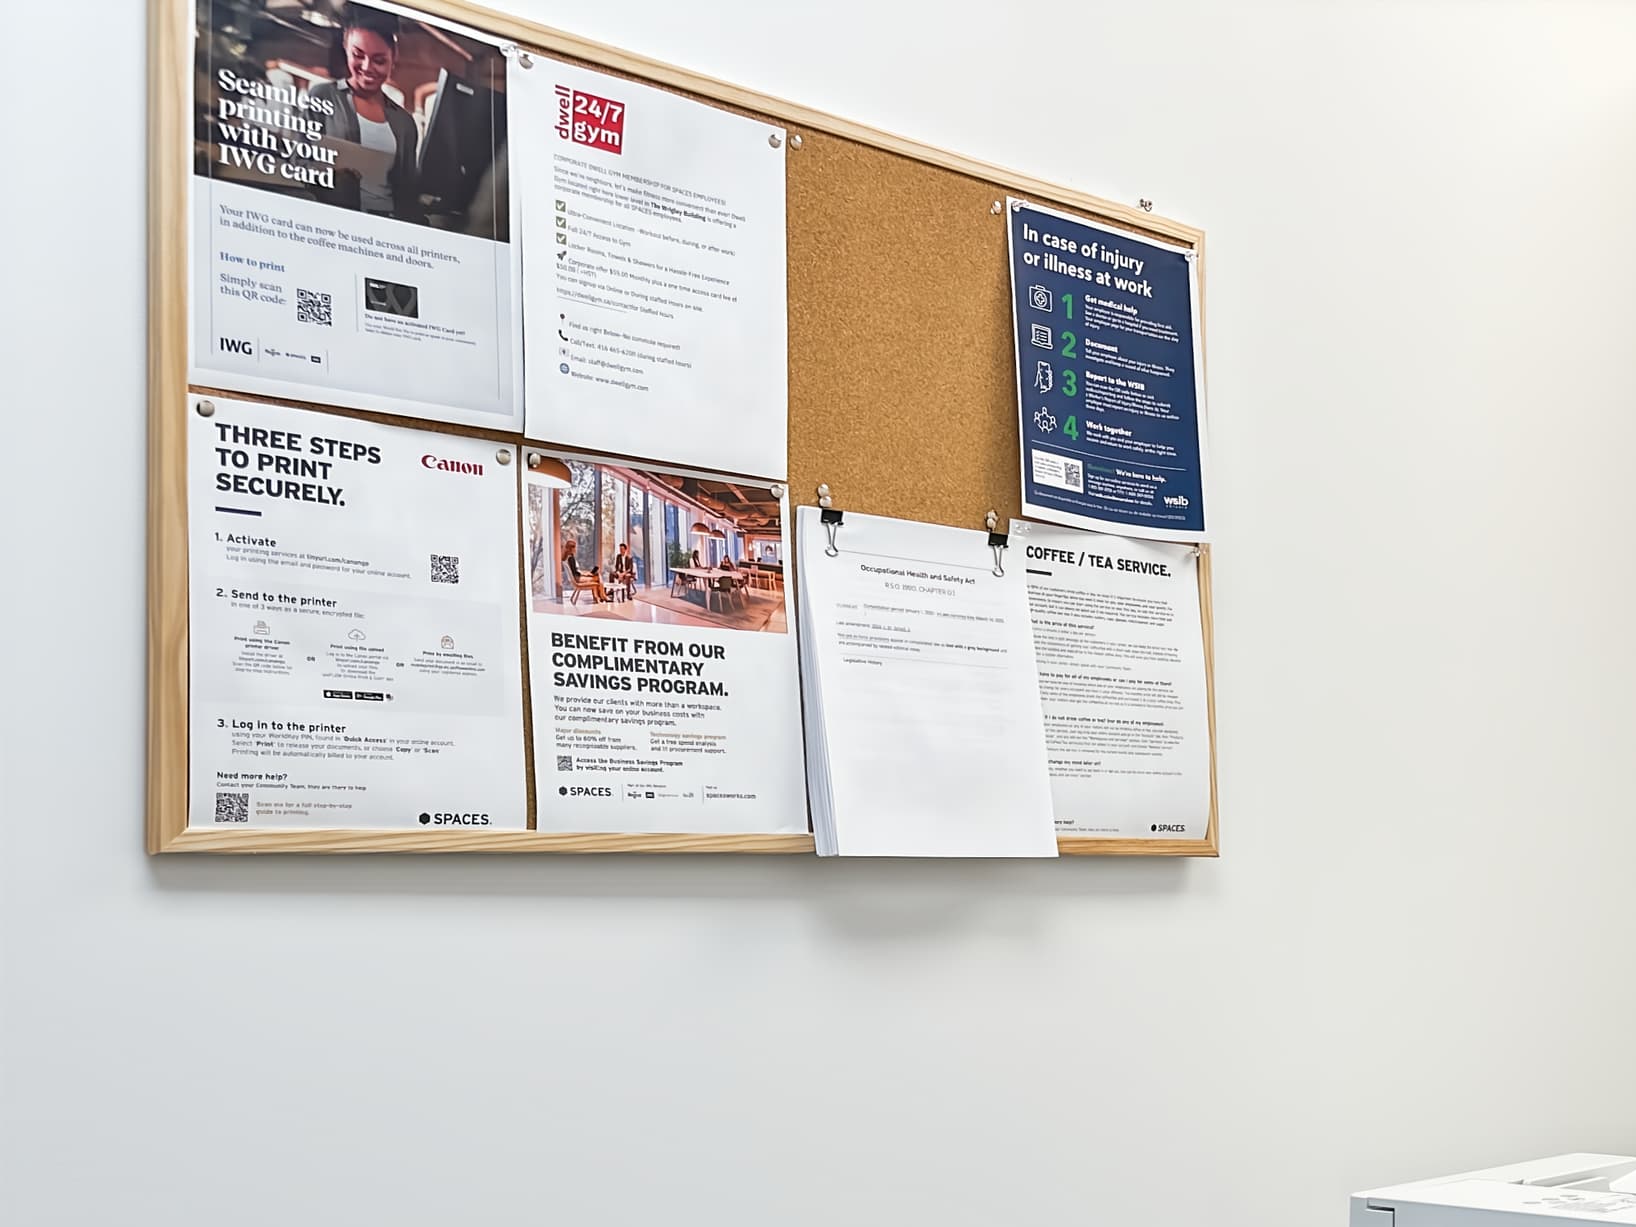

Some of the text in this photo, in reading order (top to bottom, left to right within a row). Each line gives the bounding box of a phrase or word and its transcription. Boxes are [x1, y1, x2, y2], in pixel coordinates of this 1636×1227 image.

[218, 69, 334, 116] Seamless
[218, 97, 323, 141] printing
[554, 84, 571, 140] dwell
[574, 95, 622, 125] 24/7
[218, 122, 338, 165] with your
[574, 121, 620, 146] gym
[218, 143, 334, 188] IWG card
[651, 202, 660, 210] The
[683, 210, 706, 222] Building
[219, 204, 461, 263] Your IWG card can now be used across all printers,
[220, 216, 432, 268] in addition to the coffee machines and doors.
[1023, 223, 1144, 275] In case of injury
[219, 252, 285, 272] How to print
[220, 273, 282, 293] Simply scan
[1023, 252, 1153, 298] or illness at work
[220, 285, 241, 296] this
[241, 290, 259, 301] QR
[1085, 294, 1139, 315] Get medical help
[1061, 293, 1073, 320] 1
[220, 338, 253, 355] IWG
[1061, 331, 1076, 359] 2
[1085, 338, 1118, 353] Document
[1061, 369, 1077, 397] 3
[1086, 370, 1145, 391] Report to the WSIB
[1063, 415, 1079, 441] 4
[1086, 420, 1132, 437] Work together
[215, 422, 381, 464] THREE STEPS
[215, 447, 333, 480] TO PRINT
[421, 454, 484, 477] Canon
[216, 473, 346, 507] SECURELY.
[1164, 496, 1189, 506] wsib
[214, 532, 277, 547] 1. Activate
[1026, 545, 1171, 577] COFFEE / TEA SERVICE.
[860, 564, 976, 585] Occupational Health and Safety Act
[216, 588, 338, 609] 2. Send to the printer
[551, 632, 726, 660] BENEFIT FROM OUR
[552, 652, 704, 677] COMPLIMENTARY
[553, 672, 729, 697] SAVINGS PROGRAM.
[555, 704, 567, 712] You
[605, 698, 629, 706] clients
[232, 719, 254, 731] Log
[272, 721, 283, 730] to
[287, 722, 305, 731] the
[309, 722, 347, 734] printer
[620, 718, 646, 726] savings
[217, 771, 239, 780] Need
[265, 773, 288, 782] help?
